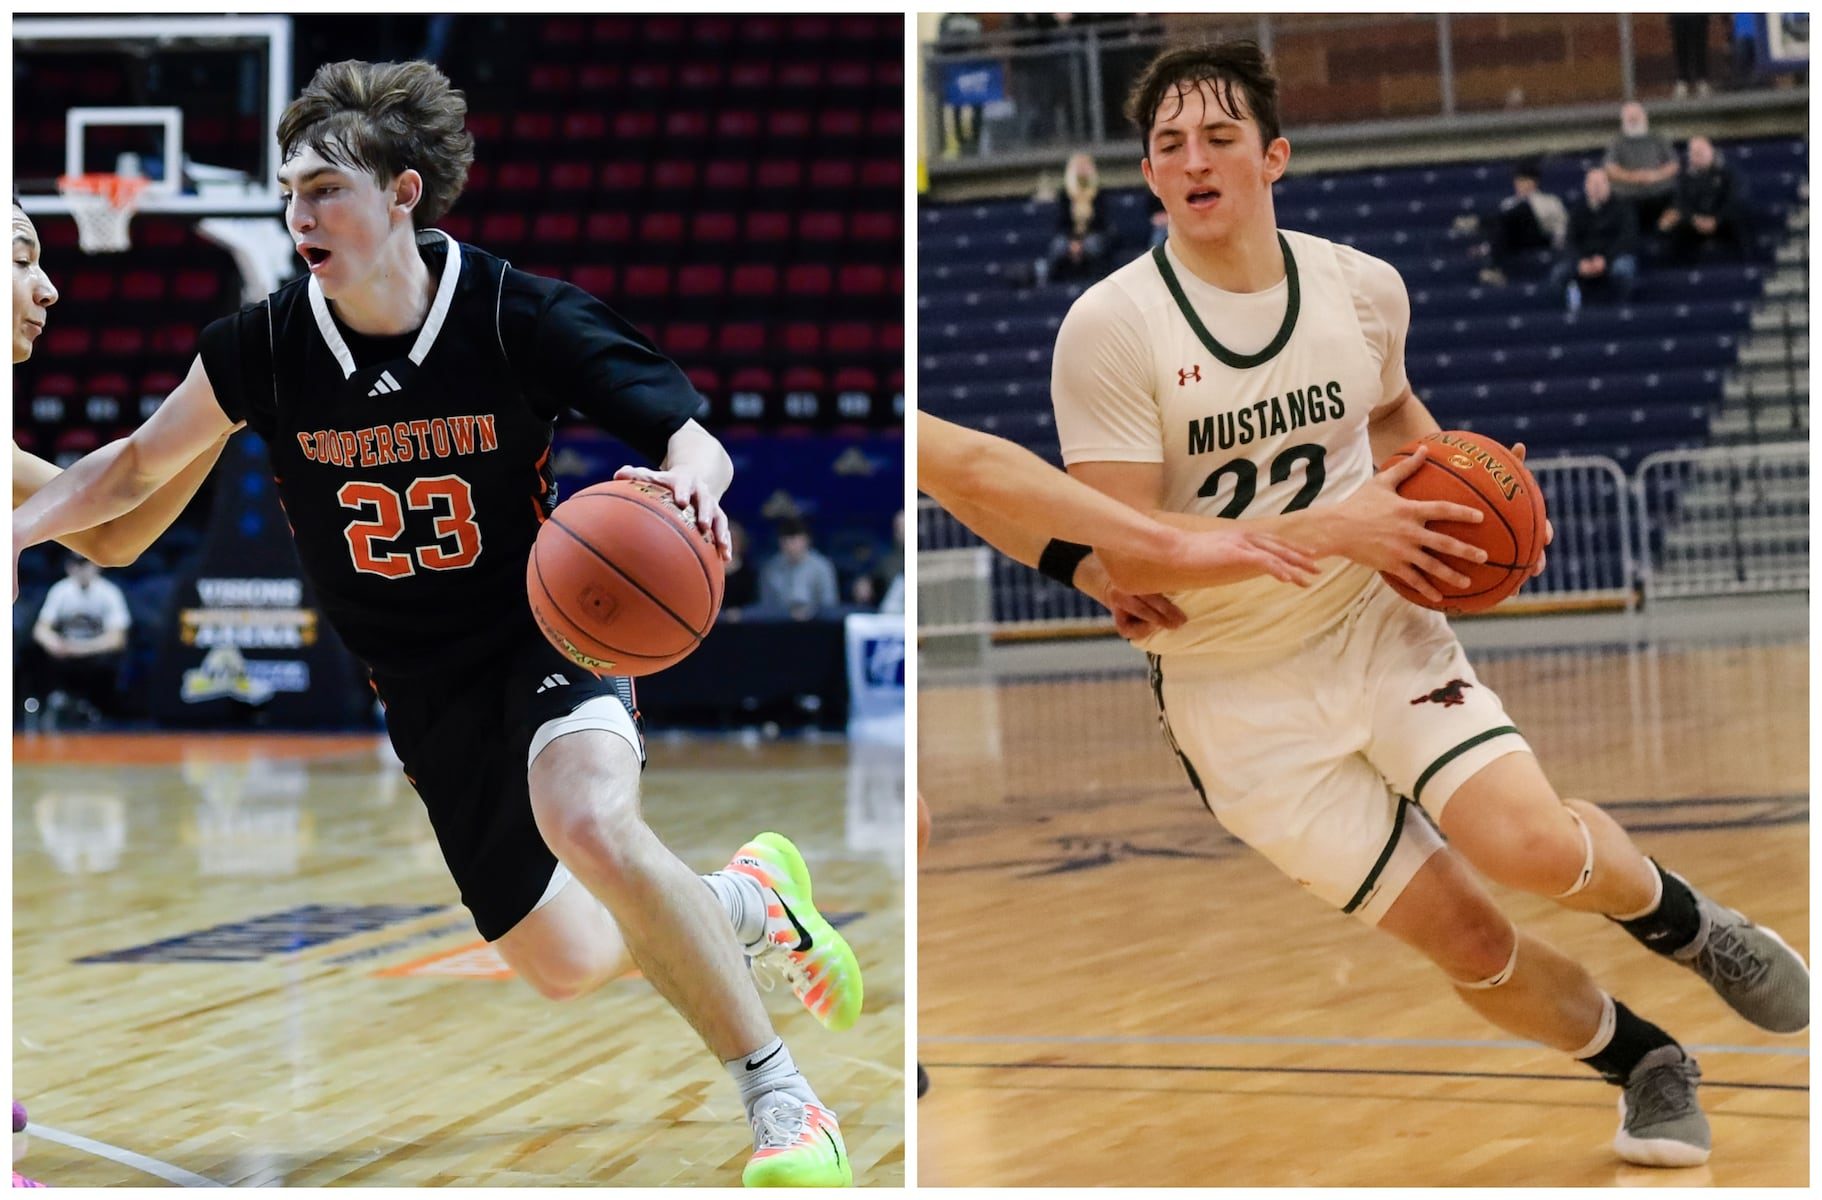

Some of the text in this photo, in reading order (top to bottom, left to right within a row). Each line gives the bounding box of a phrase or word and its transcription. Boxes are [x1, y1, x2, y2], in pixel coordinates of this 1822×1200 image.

[297, 414, 498, 468] COOPERSTOWN
[1188, 381, 1345, 456] MUSTANGS
[1197, 443, 1328, 519] 22
[336, 474, 483, 580] 23
